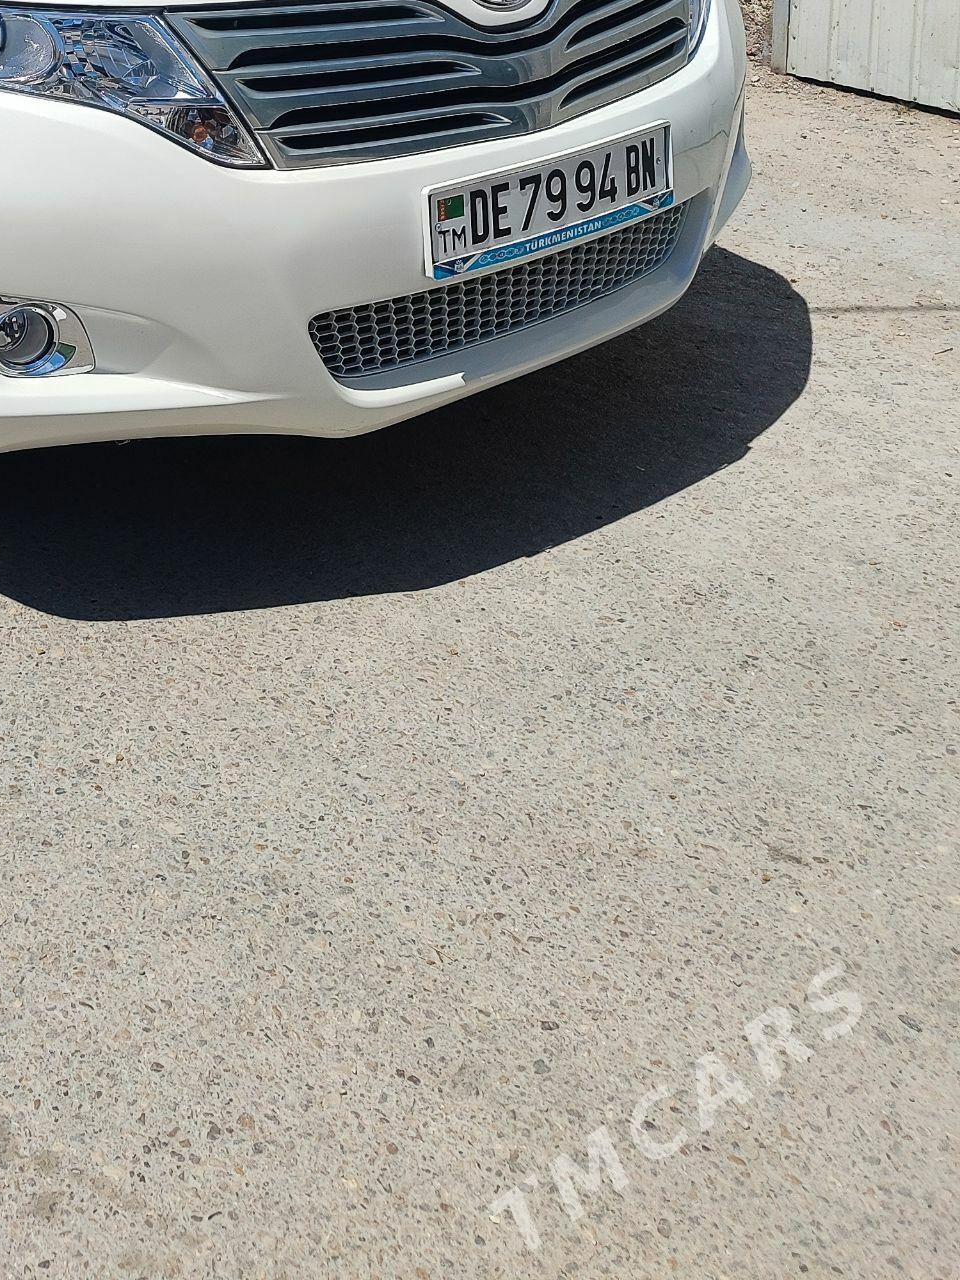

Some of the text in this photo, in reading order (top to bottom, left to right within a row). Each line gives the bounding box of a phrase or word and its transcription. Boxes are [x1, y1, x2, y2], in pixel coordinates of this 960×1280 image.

[470, 137, 656, 245] DE 79 94 BN
[437, 225, 467, 254] TM
